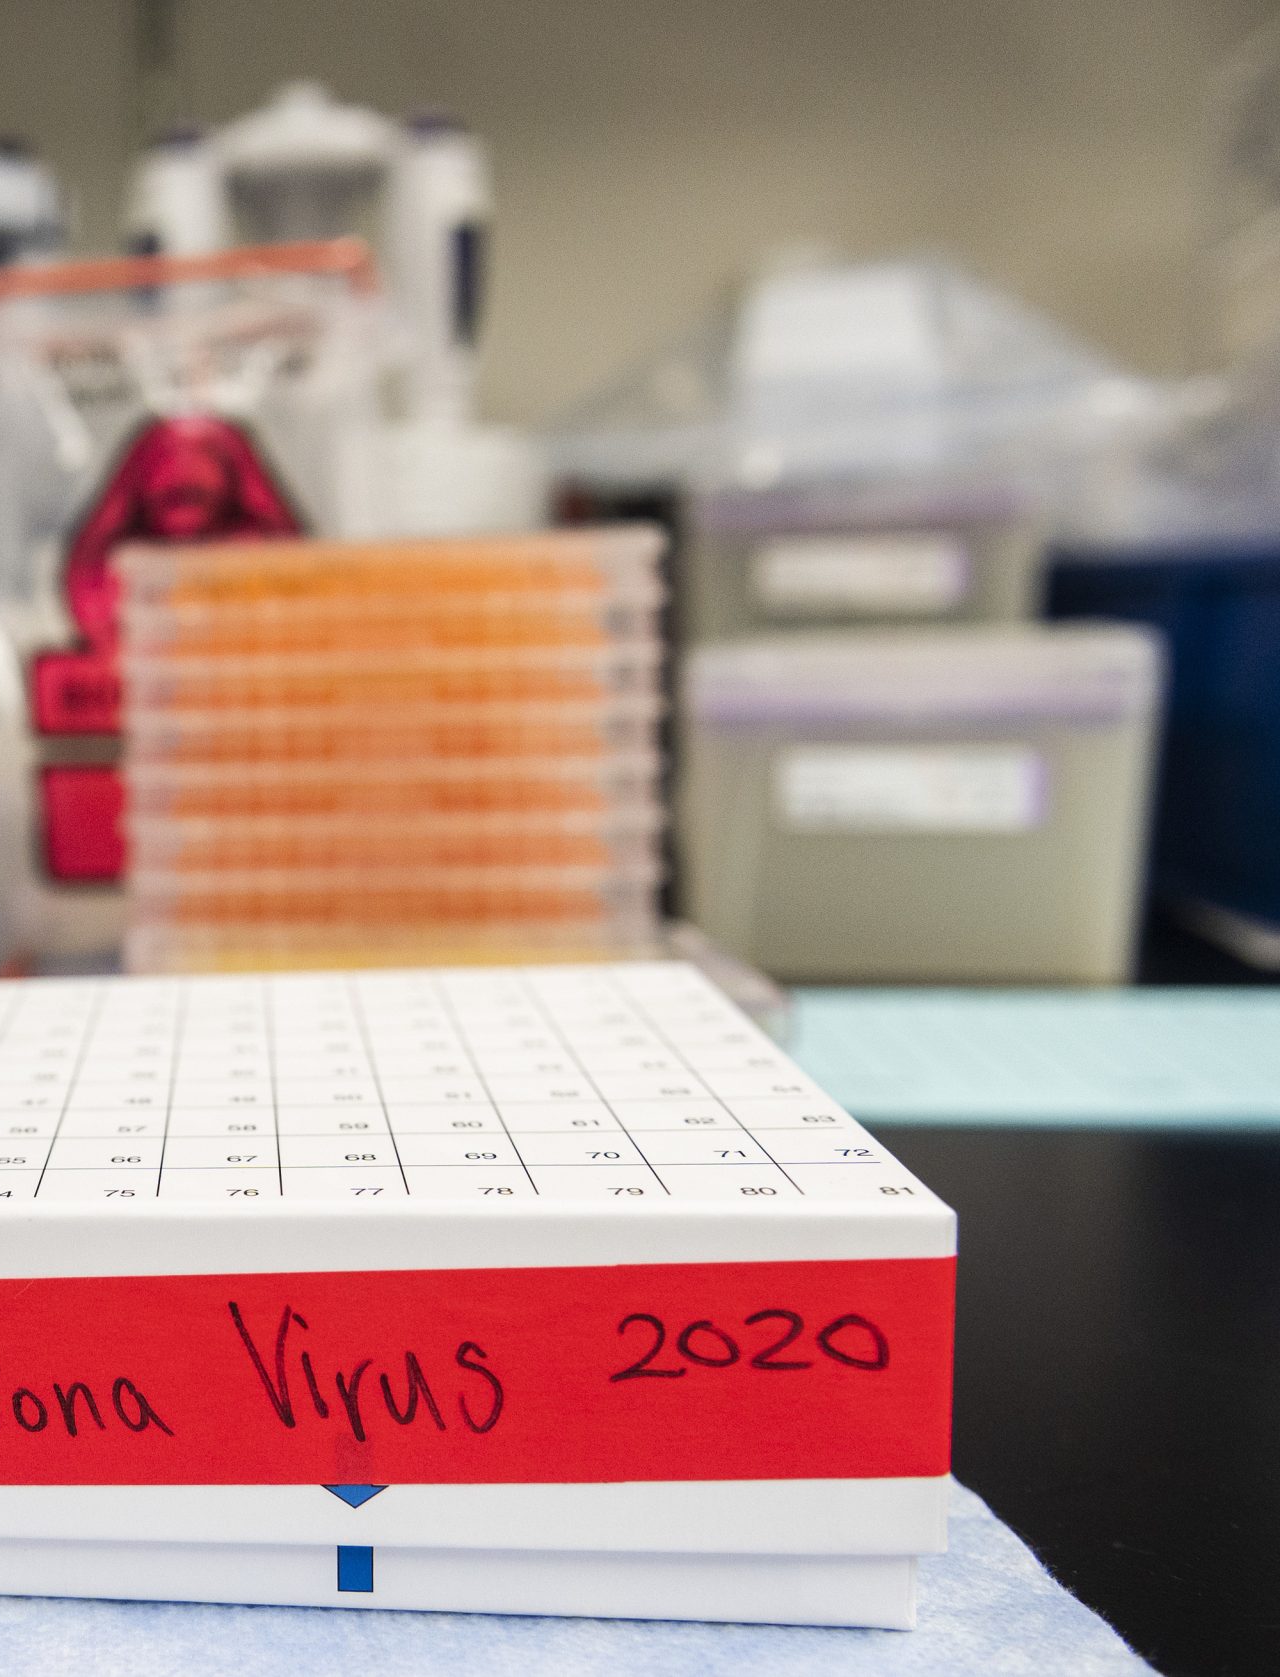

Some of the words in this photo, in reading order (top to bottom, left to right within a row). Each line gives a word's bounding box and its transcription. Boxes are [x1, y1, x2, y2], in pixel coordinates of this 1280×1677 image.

[117, 1125, 147, 1134] 57
[571, 1119, 600, 1127] 61
[683, 1117, 715, 1125] 62
[801, 1115, 836, 1123] 63
[110, 1156, 142, 1164] 66
[226, 1155, 257, 1163] 67
[344, 1153, 377, 1161] 68
[464, 1152, 498, 1160] 69
[585, 1151, 621, 1160] 70
[713, 1149, 748, 1158] 71
[834, 1148, 874, 1157] 72
[102, 1189, 137, 1198] 75
[226, 1188, 260, 1197] 76
[350, 1187, 384, 1196] 77
[478, 1187, 514, 1196] 78
[607, 1187, 645, 1196] 79
[739, 1187, 778, 1196] 80
[879, 1186, 915, 1196] 81
[228, 1301, 505, 1442] Virus
[610, 1309, 890, 1383] 2020
